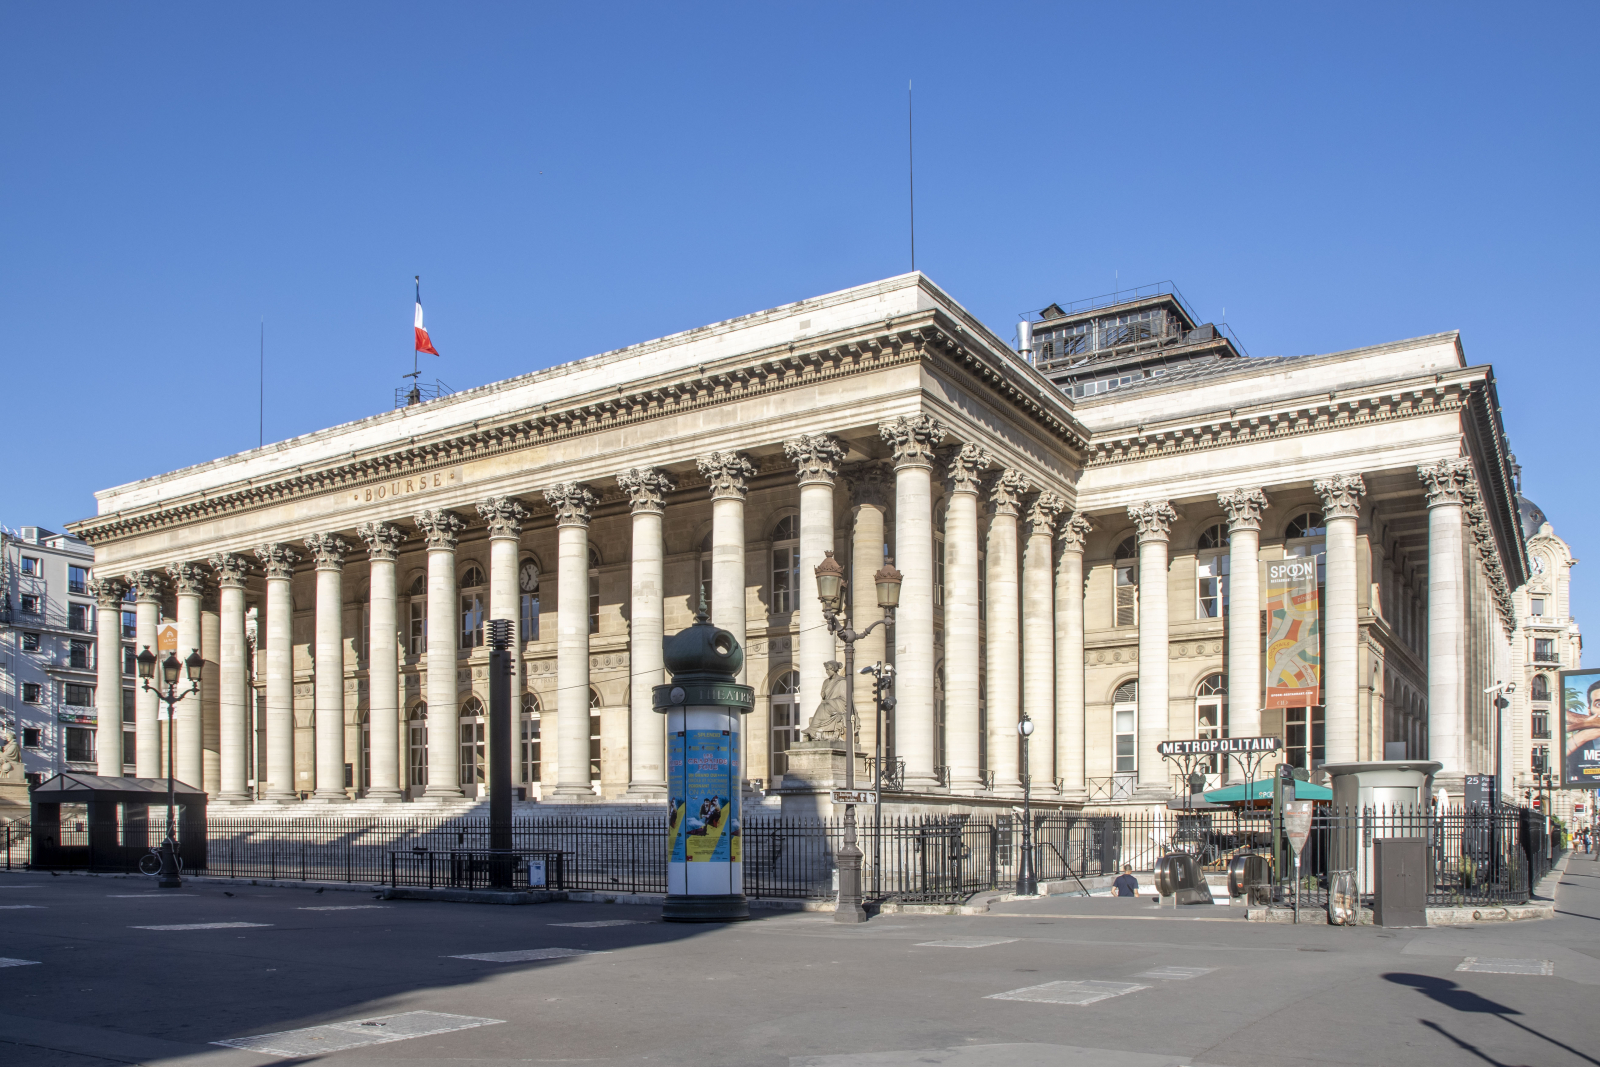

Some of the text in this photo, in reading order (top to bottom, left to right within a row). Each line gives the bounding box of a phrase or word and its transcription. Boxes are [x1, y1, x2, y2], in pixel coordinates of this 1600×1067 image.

[365, 473, 442, 502] BOURSE
[1270, 562, 1313, 578] SPOON
[1268, 642, 1290, 659] COCKTAILS
[1162, 737, 1275, 754] METROPOLITAIN
[1466, 776, 1480, 785] 25
